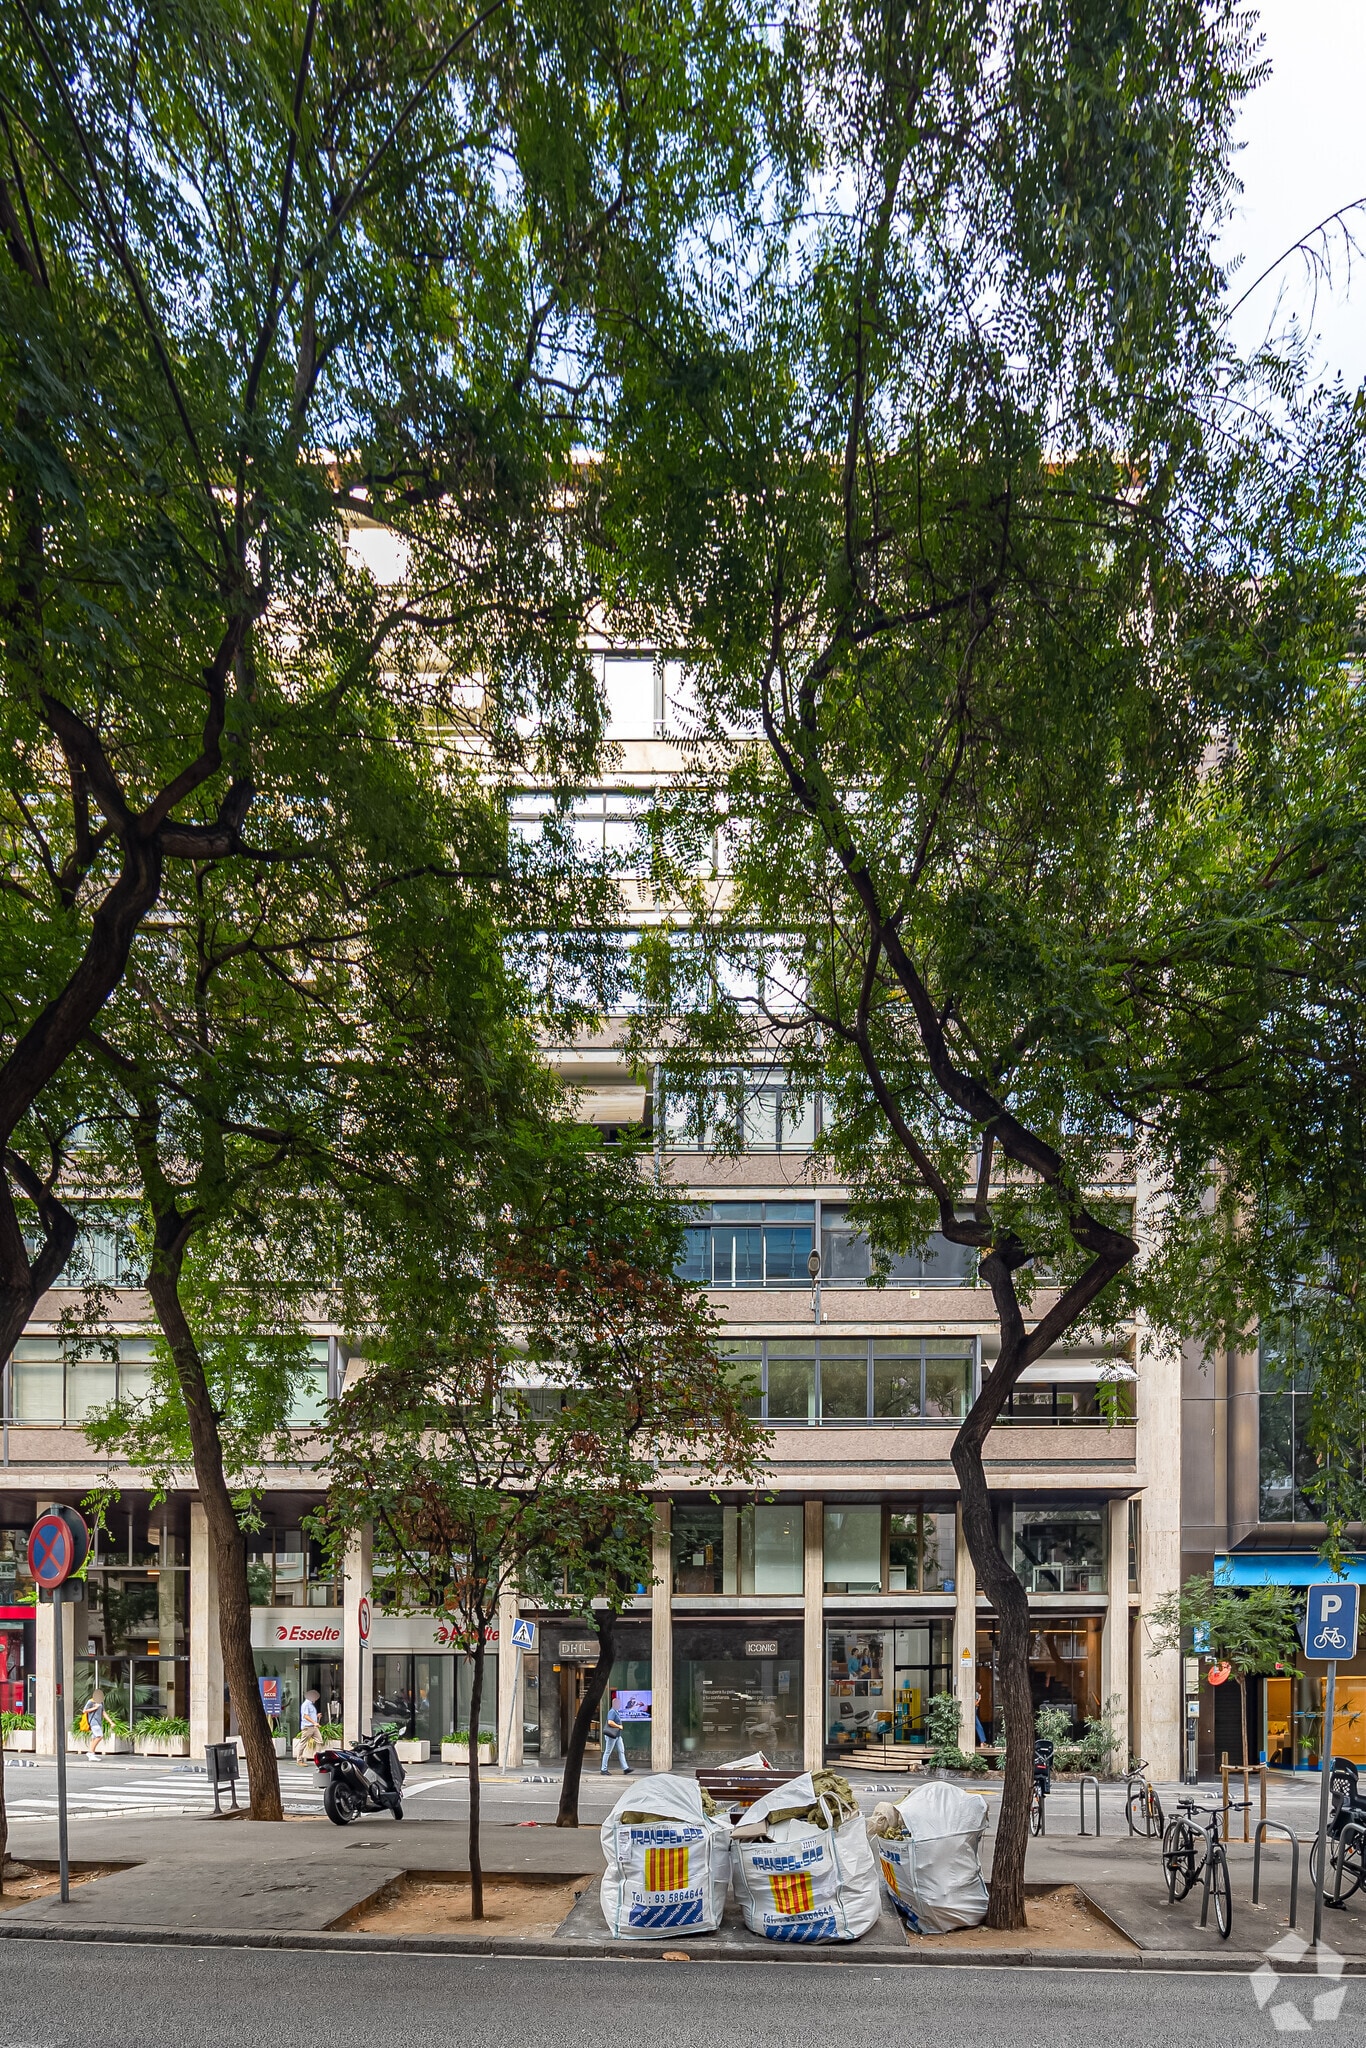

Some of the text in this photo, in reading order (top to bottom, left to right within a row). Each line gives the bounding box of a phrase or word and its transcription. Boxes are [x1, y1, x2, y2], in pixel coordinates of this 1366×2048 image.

[1320, 1594, 1342, 1622] P
[288, 1625, 340, 1641] Esselte
[449, 1625, 500, 1641] Elte
[748, 1643, 776, 1652] ICONIC
[655, 1893, 665, 1904] 93
[669, 1887, 704, 1904] 5864644
